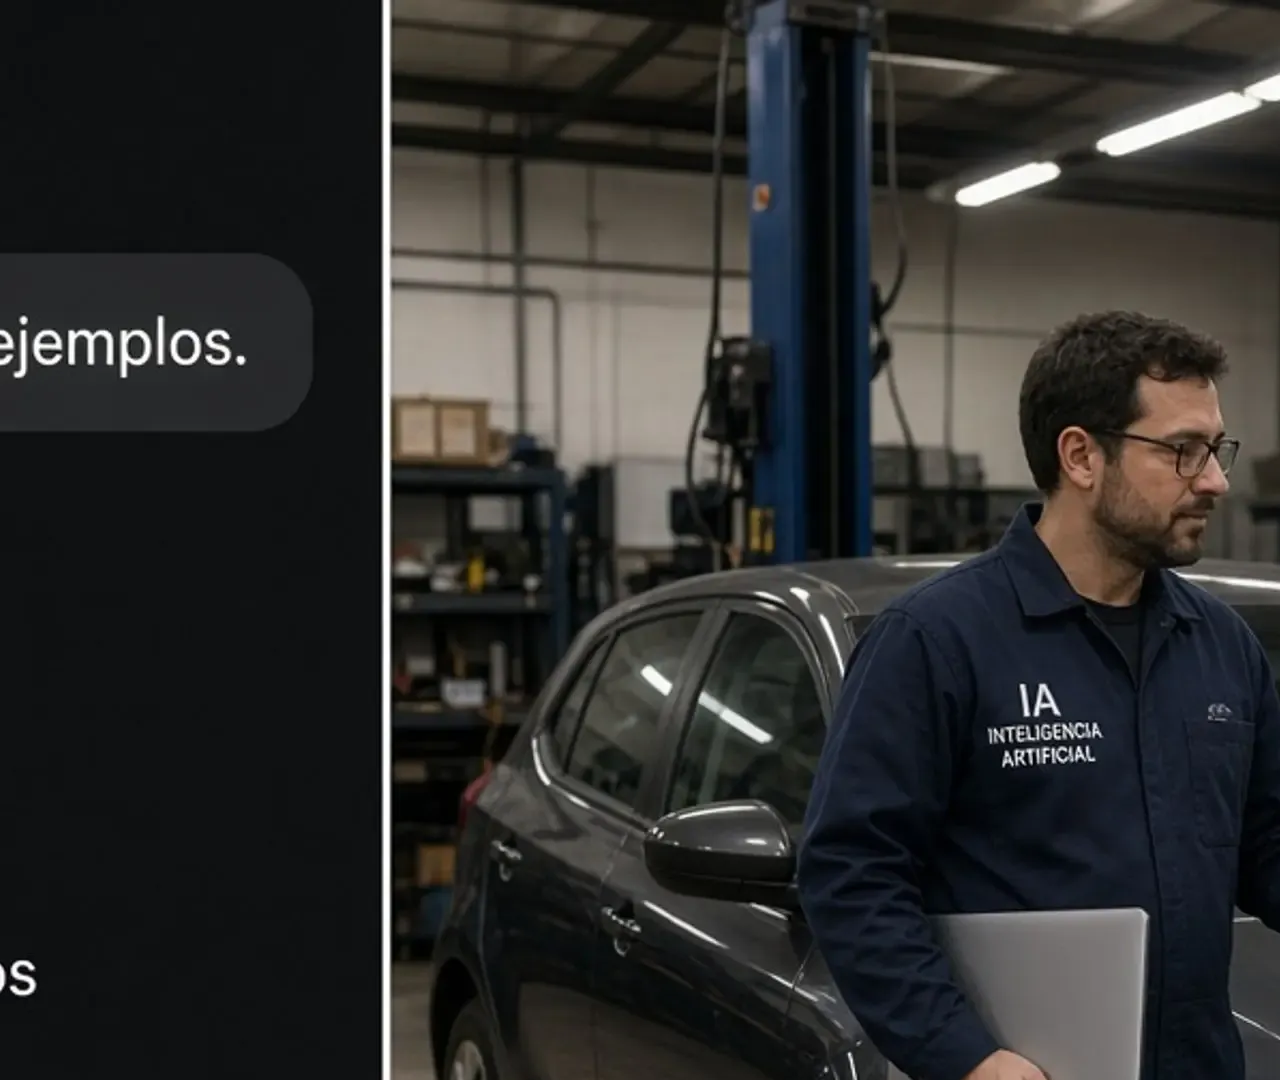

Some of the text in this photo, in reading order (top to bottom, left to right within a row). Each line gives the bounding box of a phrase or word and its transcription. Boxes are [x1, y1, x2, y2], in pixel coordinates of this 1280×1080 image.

[1019, 683, 1062, 718] IA
[987, 721, 1105, 745] INTELIGENCIA
[1001, 744, 1097, 768] ARTIFICIAL
